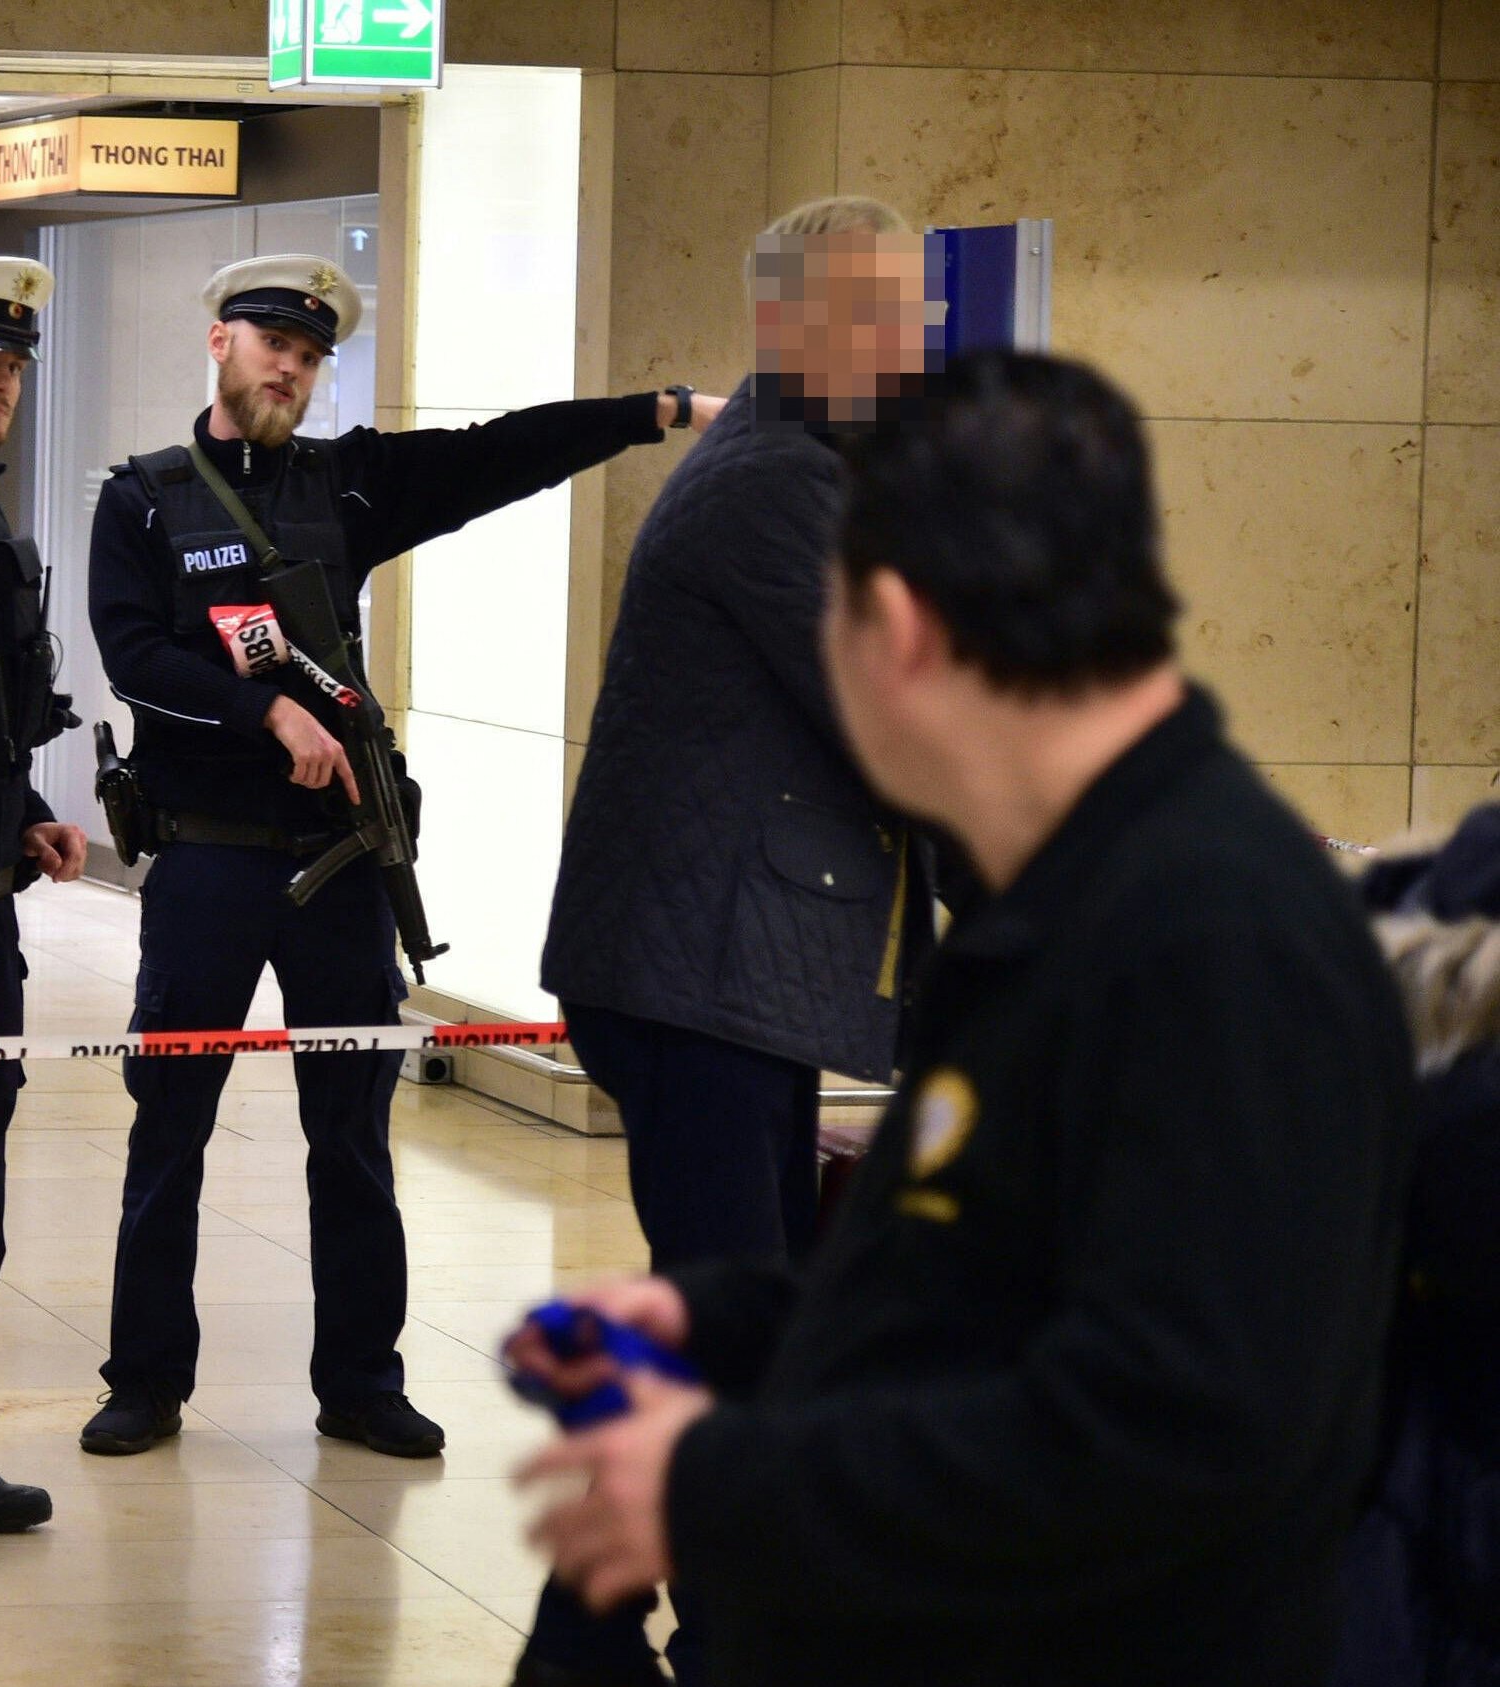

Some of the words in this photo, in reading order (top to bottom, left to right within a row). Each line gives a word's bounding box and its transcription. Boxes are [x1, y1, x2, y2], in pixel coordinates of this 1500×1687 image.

[41, 134, 68, 178] THAI
[91, 144, 168, 166] THONG
[175, 147, 225, 168] THAI
[183, 544, 248, 573] POLIZEI
